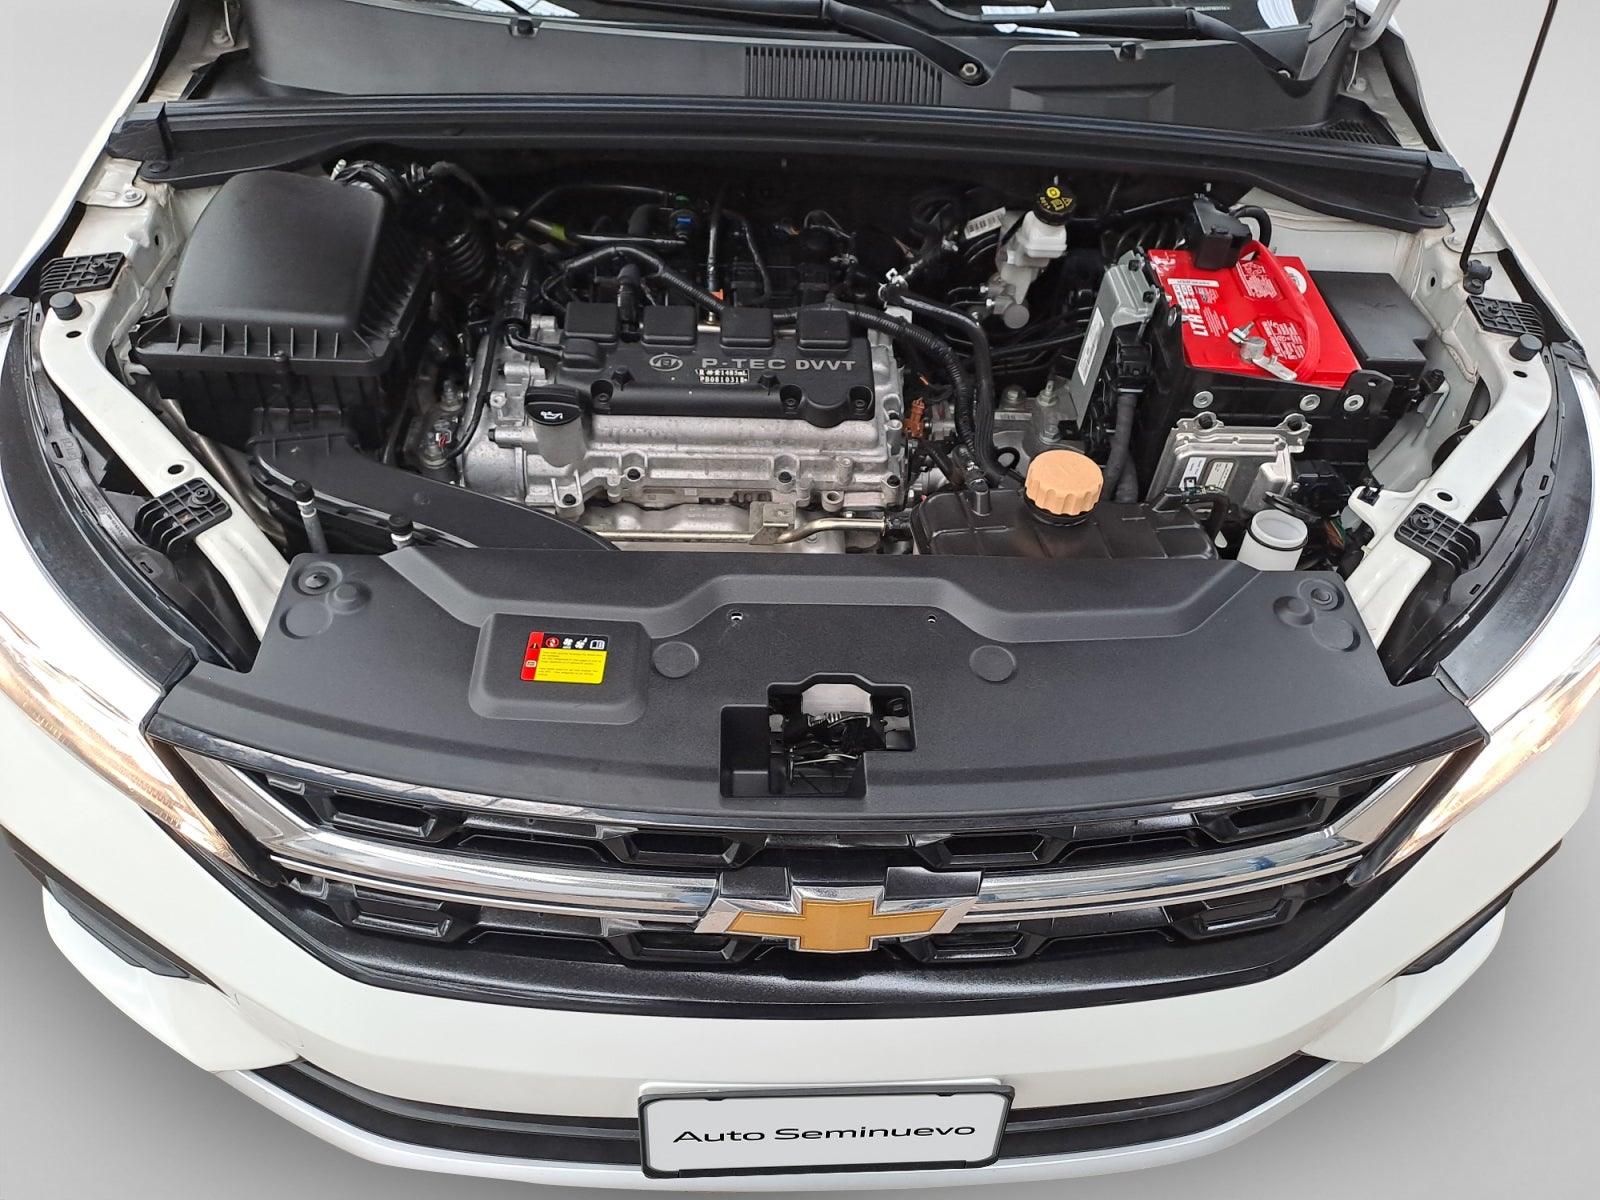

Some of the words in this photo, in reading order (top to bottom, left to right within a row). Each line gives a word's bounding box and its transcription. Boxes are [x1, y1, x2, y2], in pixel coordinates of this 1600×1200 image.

[701, 357, 787, 370] P-TEC
[795, 359, 857, 371] DVVT
[673, 1129, 765, 1143] Auto
[774, 1126, 977, 1141] Seminuevo
